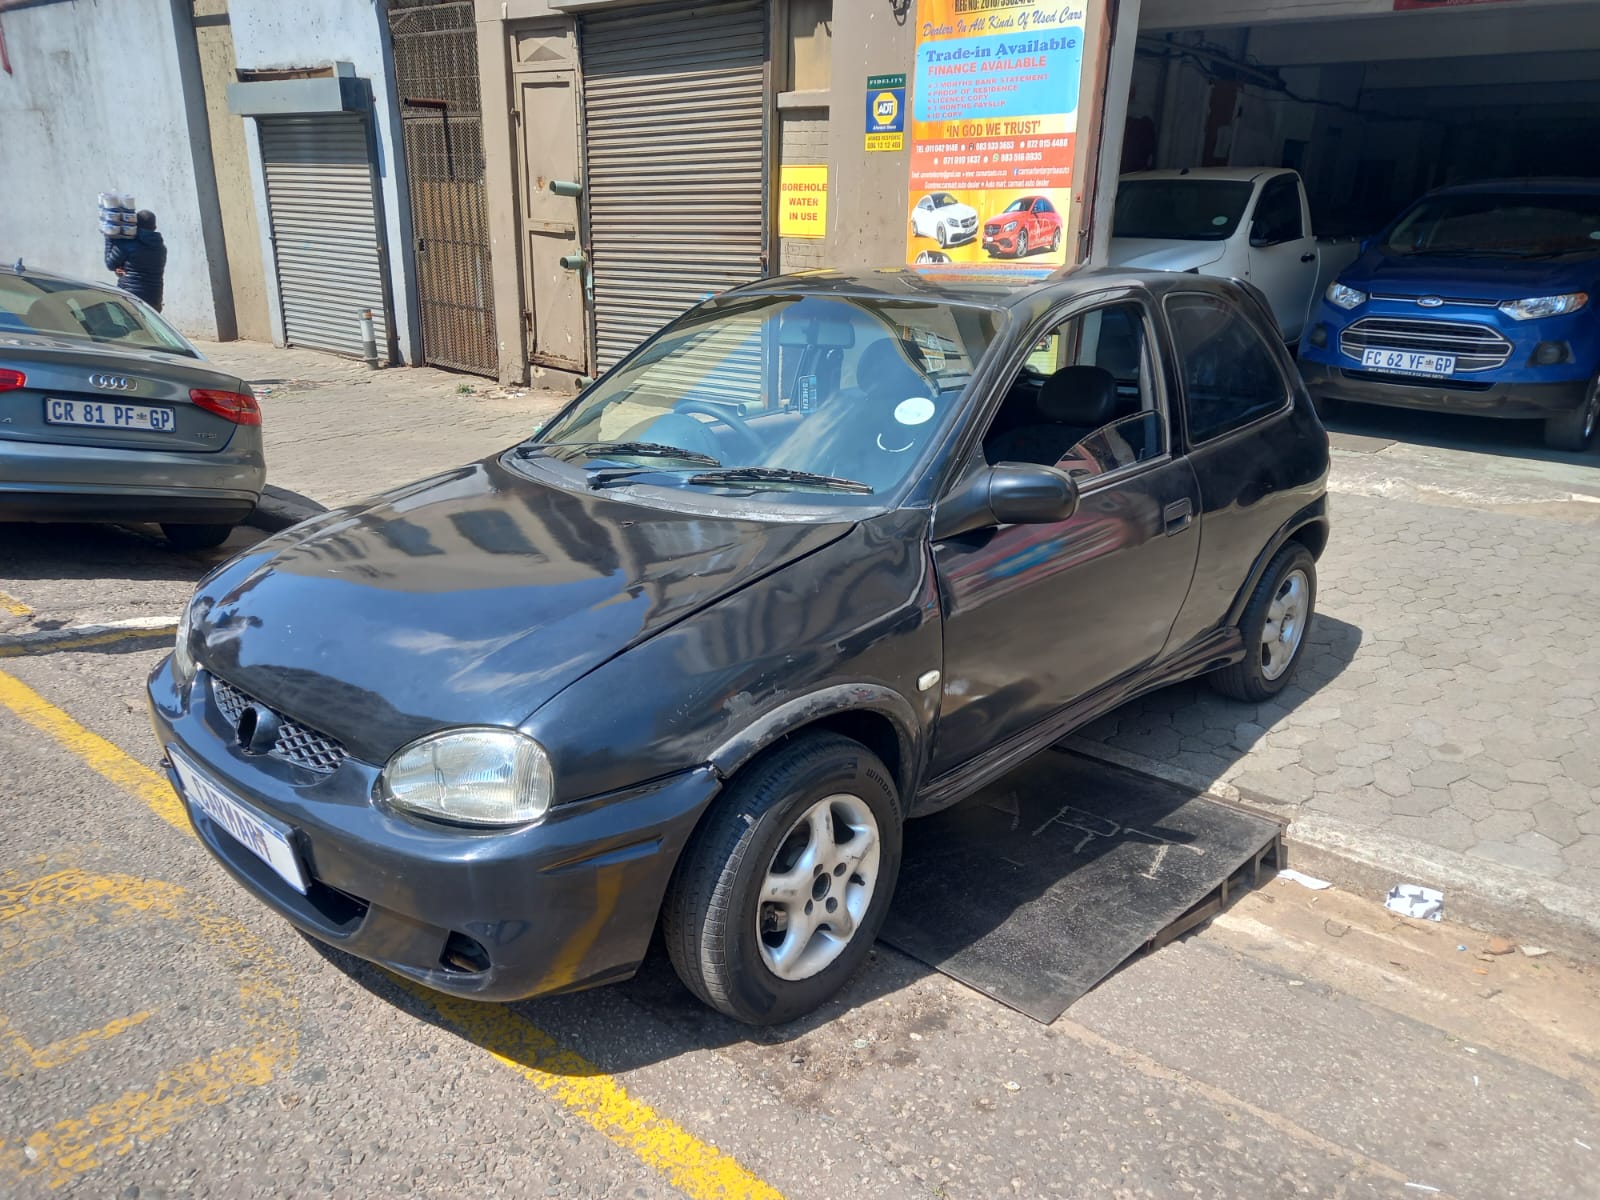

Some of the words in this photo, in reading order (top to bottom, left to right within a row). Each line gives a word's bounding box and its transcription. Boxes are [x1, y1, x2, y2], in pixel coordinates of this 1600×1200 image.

[923, 23, 954, 37] Dealers
[957, 19, 967, 33] In
[969, 17, 986, 32] All
[988, 15, 1014, 29] Kinds
[1018, 12, 1029, 30] Of
[1032, 10, 1056, 24] Used
[1059, 6, 1082, 23] Cars
[926, 47, 991, 63] Trade-in
[995, 37, 1077, 58] Available
[928, 62, 976, 76] FINANCE
[981, 56, 1047, 72] AVAILABLE
[869, 77, 904, 85] FIDELITY
[878, 102, 894, 115] ADT
[962, 124, 983, 137] GOD
[985, 123, 1001, 136] WE
[782, 183, 828, 192] BOREHOLE
[789, 197, 819, 206] WATER
[789, 212, 798, 221] IN
[800, 212, 818, 221] USE
[1365, 351, 1382, 365] FC
[1387, 353, 1403, 367] 62
[1409, 354, 1425, 369] YF
[1434, 357, 1452, 372] GP
[52, 401, 74, 421] CR
[84, 404, 105, 424] 81
[114, 406, 134, 426] PF
[150, 410, 170, 428] GP
